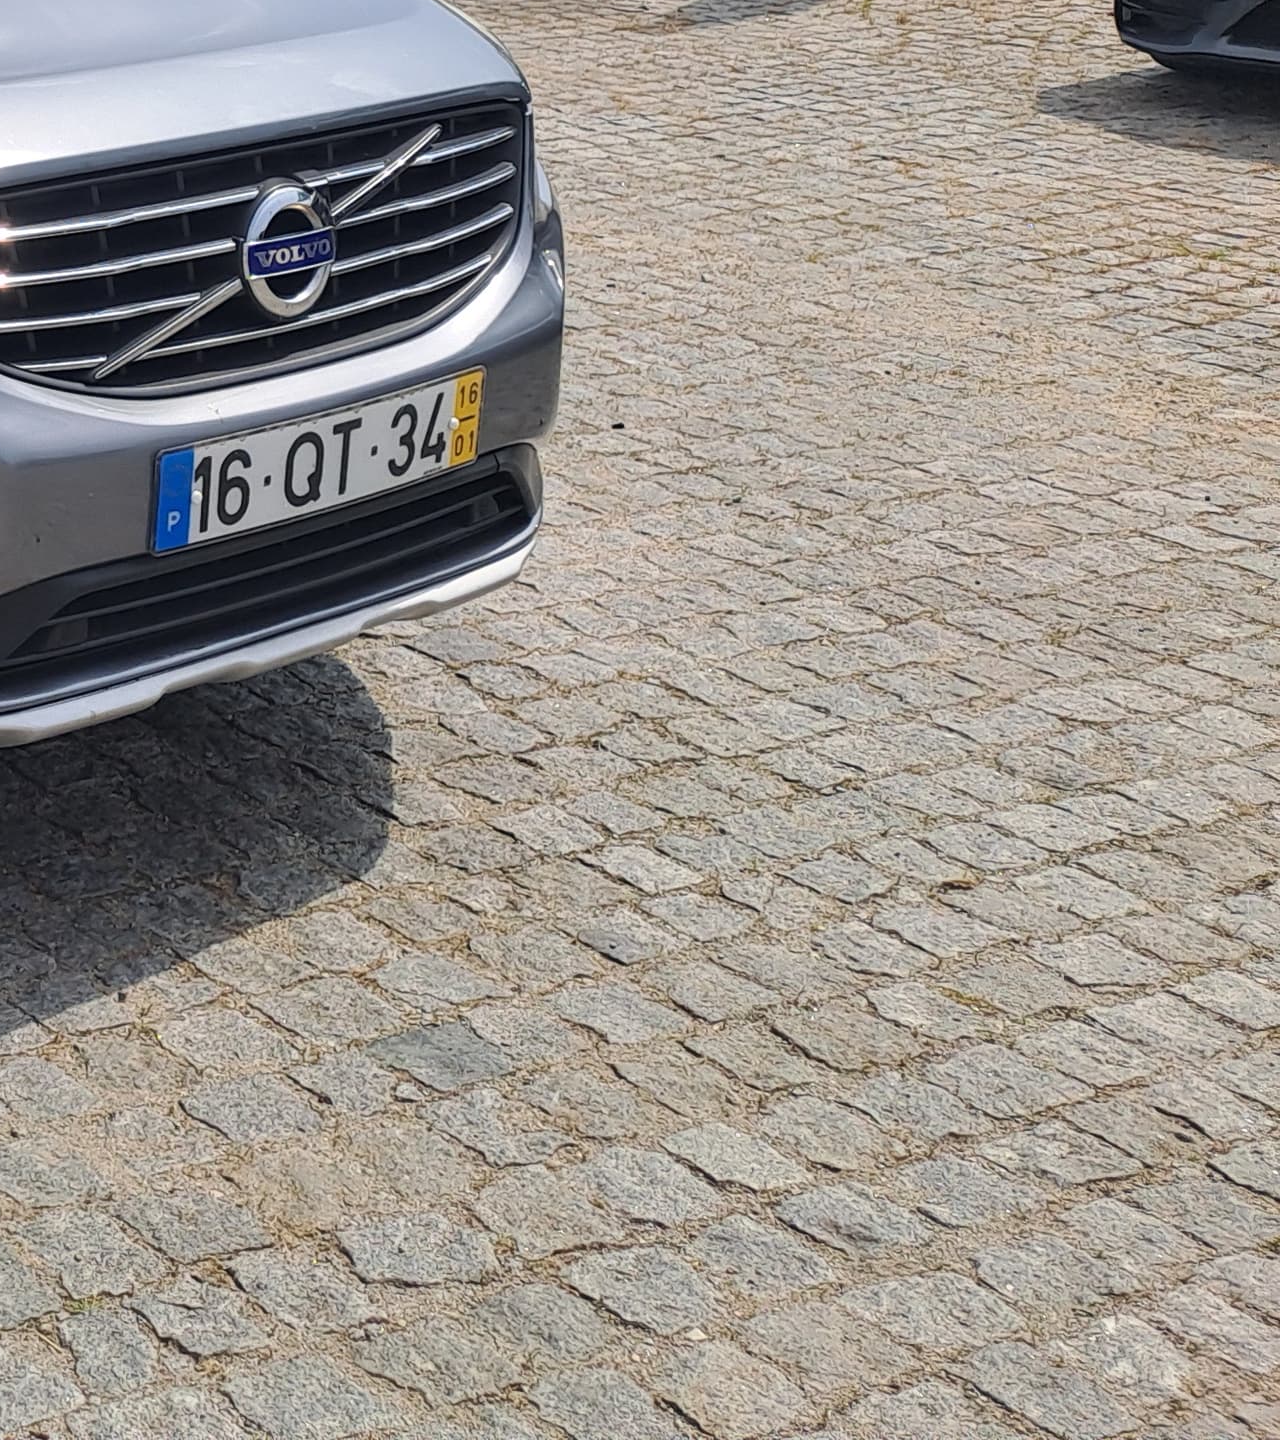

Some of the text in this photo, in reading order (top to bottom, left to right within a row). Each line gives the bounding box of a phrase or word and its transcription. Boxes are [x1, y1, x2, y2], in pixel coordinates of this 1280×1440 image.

[253, 238, 331, 268] VOLVO
[459, 380, 479, 409] 16
[453, 434, 476, 458] 01
[166, 510, 181, 532] P
